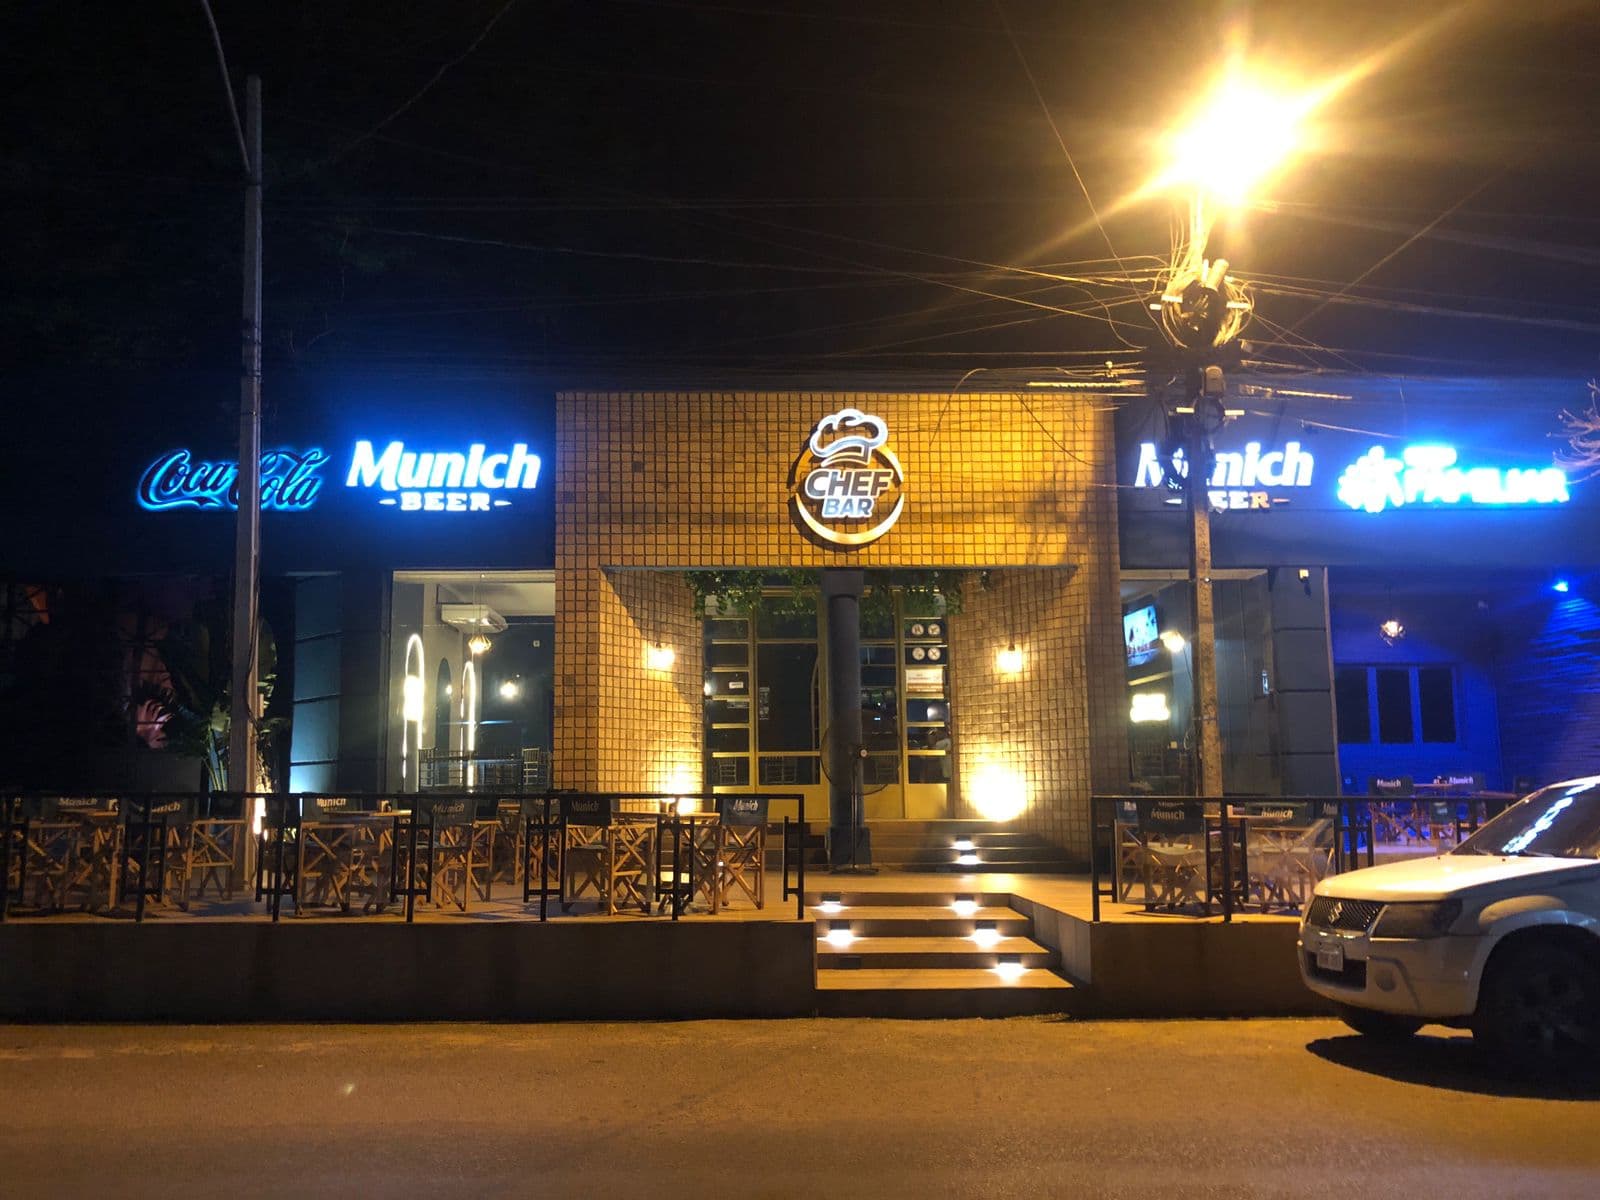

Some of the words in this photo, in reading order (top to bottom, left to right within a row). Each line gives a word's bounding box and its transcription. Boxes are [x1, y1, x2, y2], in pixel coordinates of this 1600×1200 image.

[345, 440, 542, 491] Munich
[1134, 441, 1314, 487] Mnich
[806, 470, 893, 498] CHEF
[400, 491, 491, 512] BEER
[823, 497, 873, 517] BAR
[1207, 490, 1270, 510] EER
